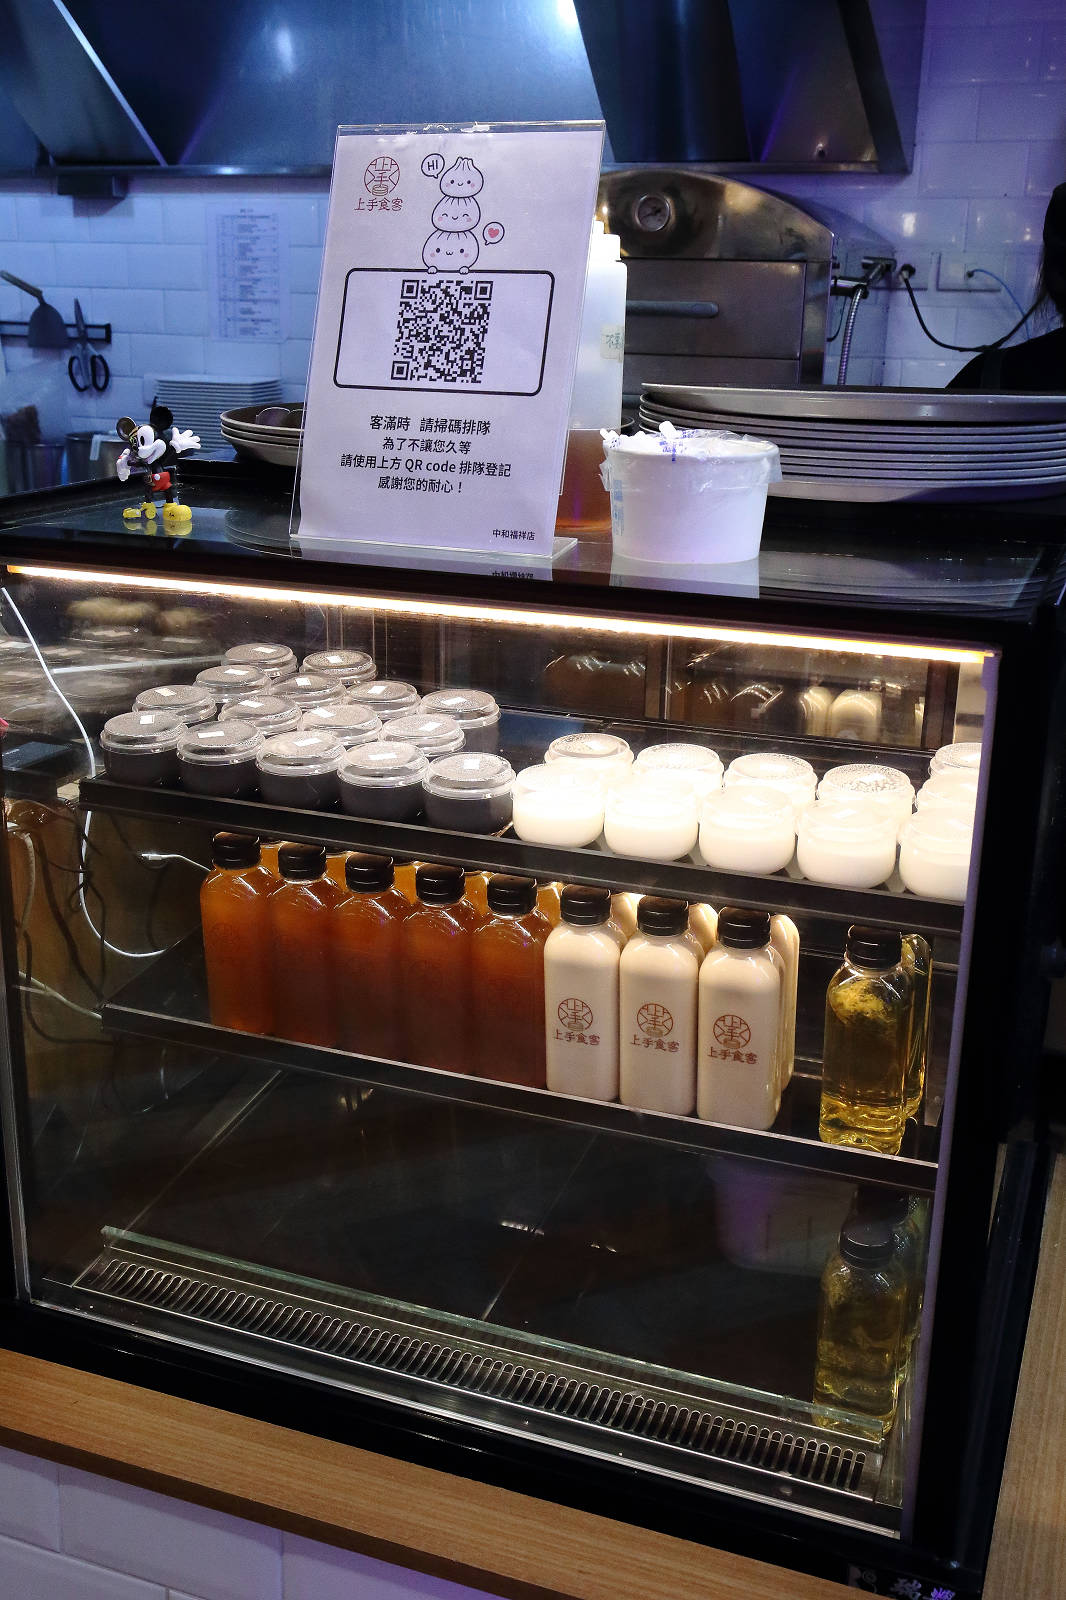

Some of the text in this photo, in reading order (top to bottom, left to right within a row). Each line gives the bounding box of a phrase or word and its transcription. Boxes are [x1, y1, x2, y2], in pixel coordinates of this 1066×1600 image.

[427, 160, 439, 171] HI
[354, 197, 403, 212] 上手食客
[370, 415, 491, 436] 客滿時 請掃碼排隊
[382, 437, 472, 455] 為了不讓您久等
[340, 453, 512, 478] 請使用上方 QR code 排隊登記
[492, 529, 536, 541] 中和福祥店
[554, 1029, 601, 1046] 上手食客
[630, 1034, 680, 1053] 上手食客
[707, 1046, 759, 1065] 上手食客
